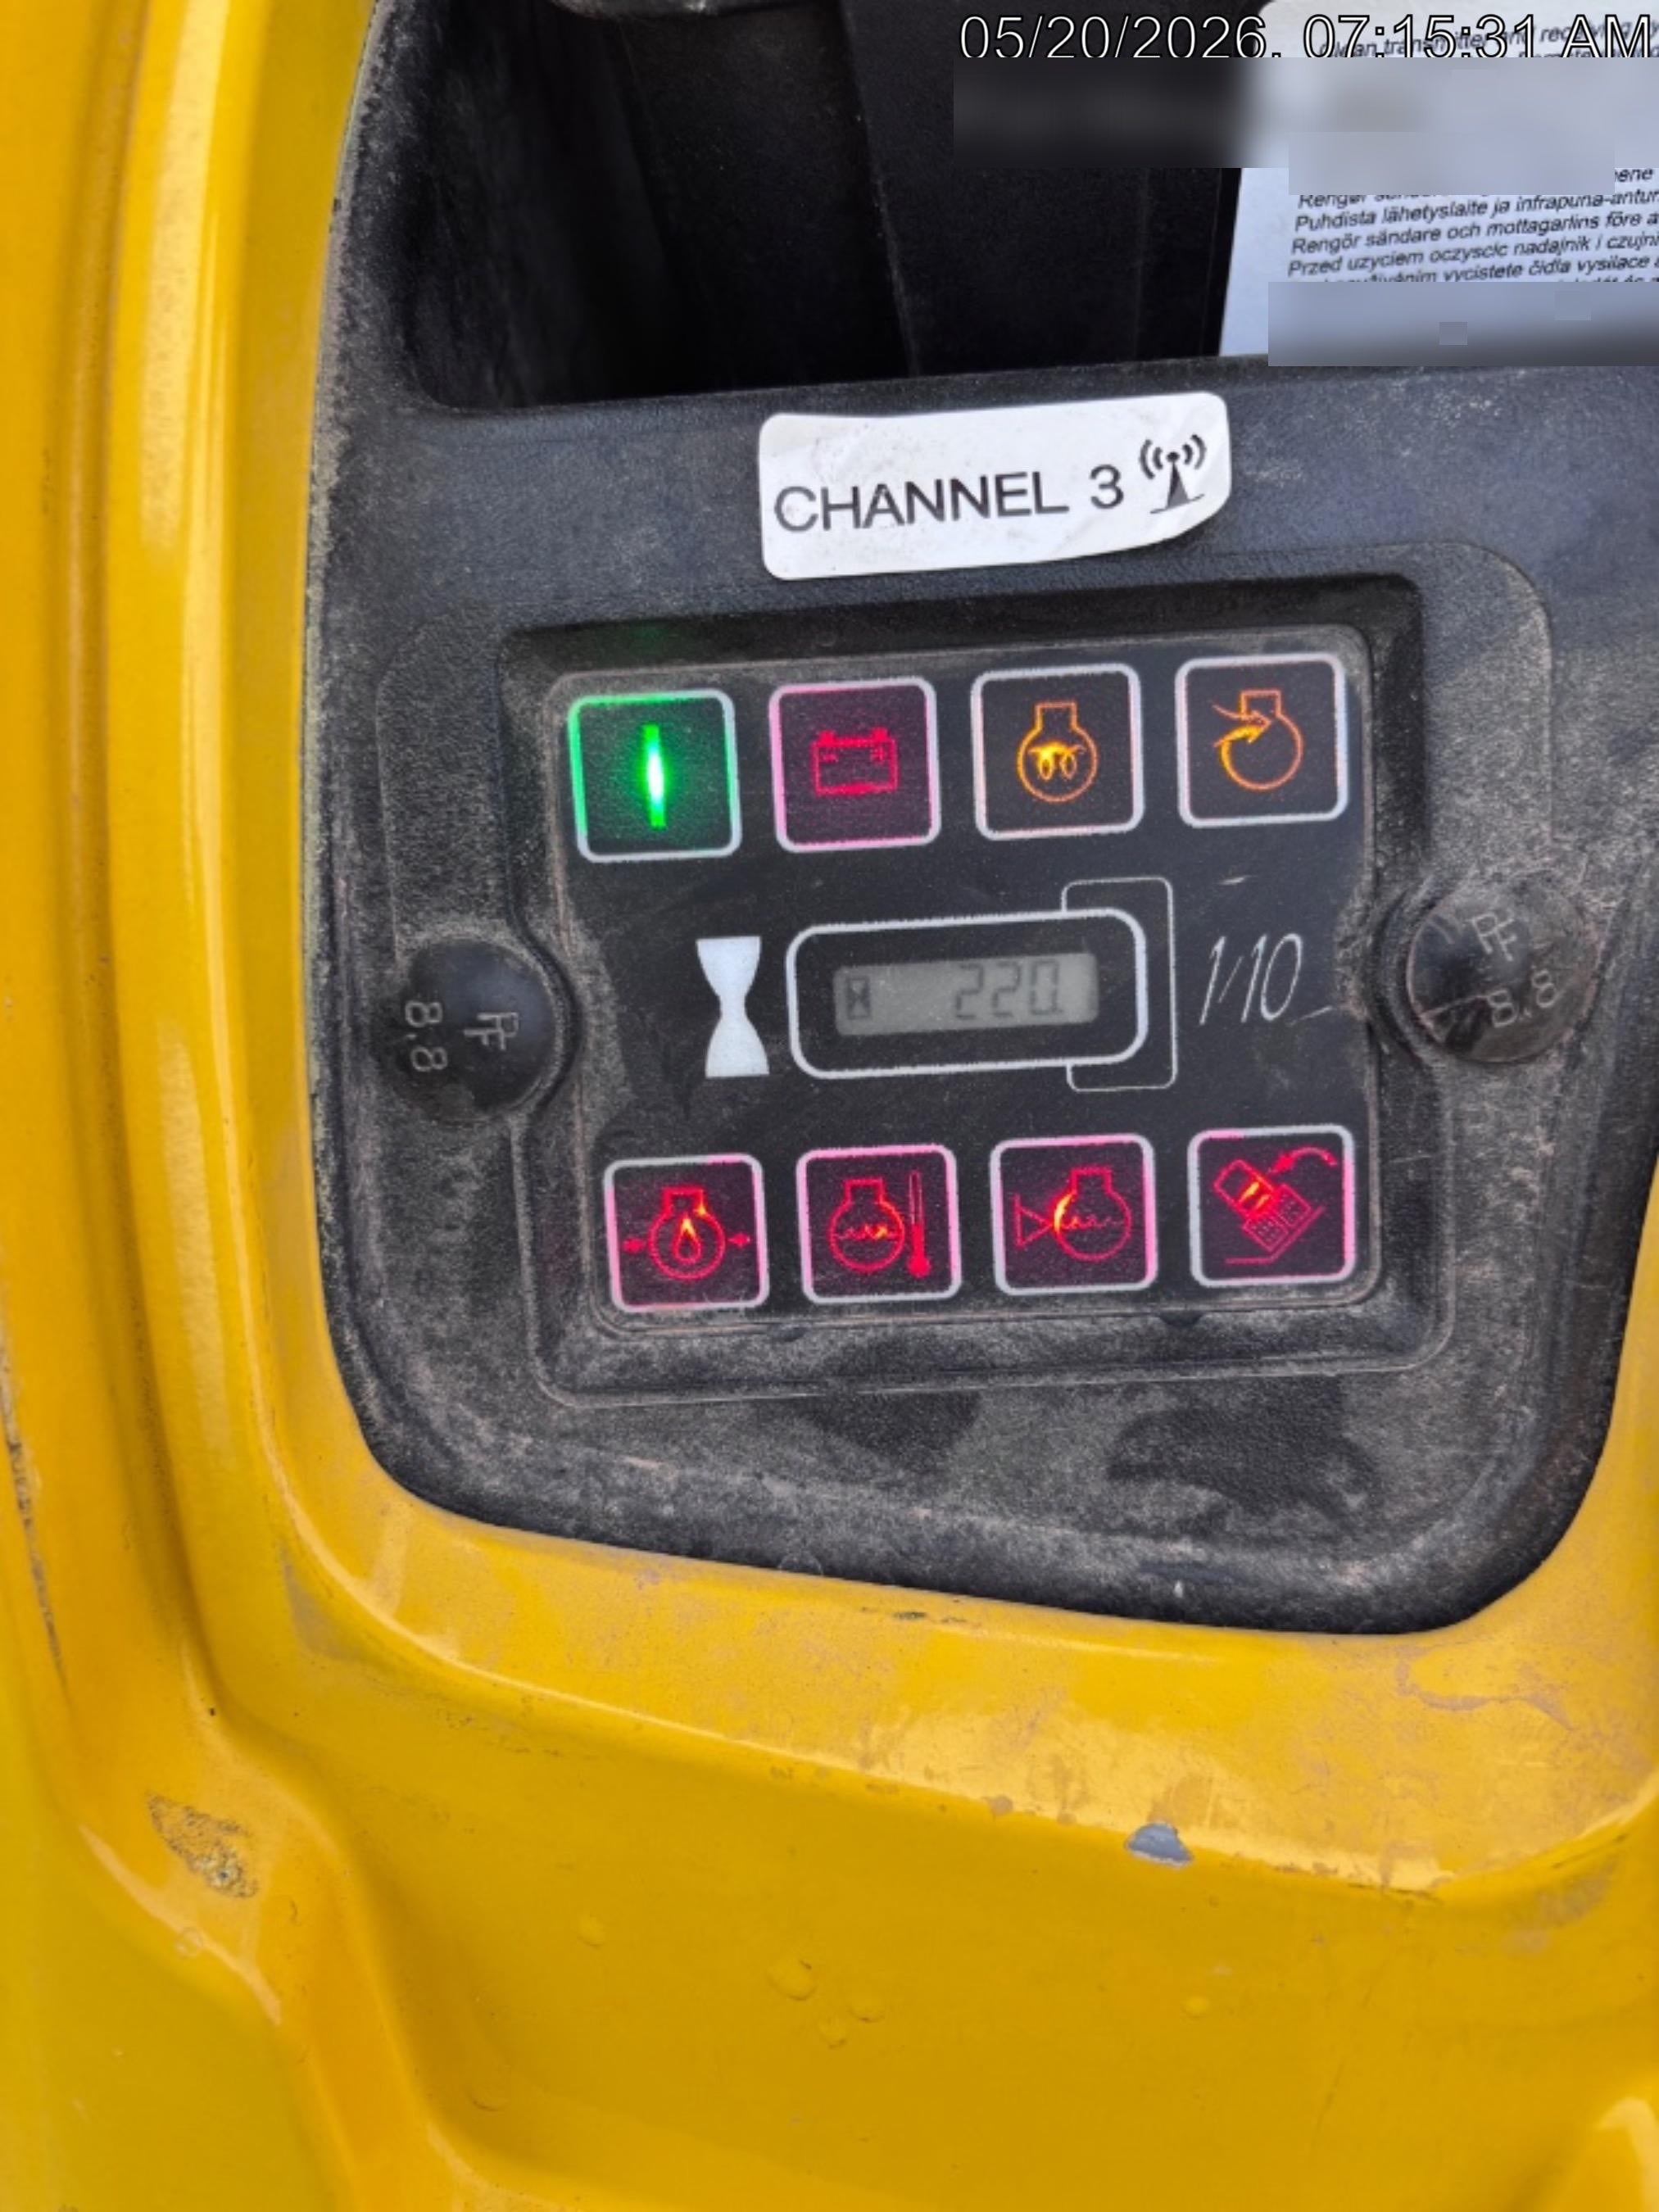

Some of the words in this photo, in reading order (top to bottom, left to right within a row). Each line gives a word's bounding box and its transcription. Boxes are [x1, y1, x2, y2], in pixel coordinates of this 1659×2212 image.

[1295, 211, 1376, 232] Puhdista
[1489, 197, 1510, 219] ja
[1287, 256, 1344, 277] Przed
[1514, 235, 1590, 256] nadajnik
[1291, 233, 1362, 256] Rengör
[1364, 228, 1441, 247] sändare
[1447, 222, 1480, 239] och
[774, 471, 1069, 532] CHANNEL
[1089, 464, 1124, 510] 3
[1199, 933, 1303, 1025] 1/10
